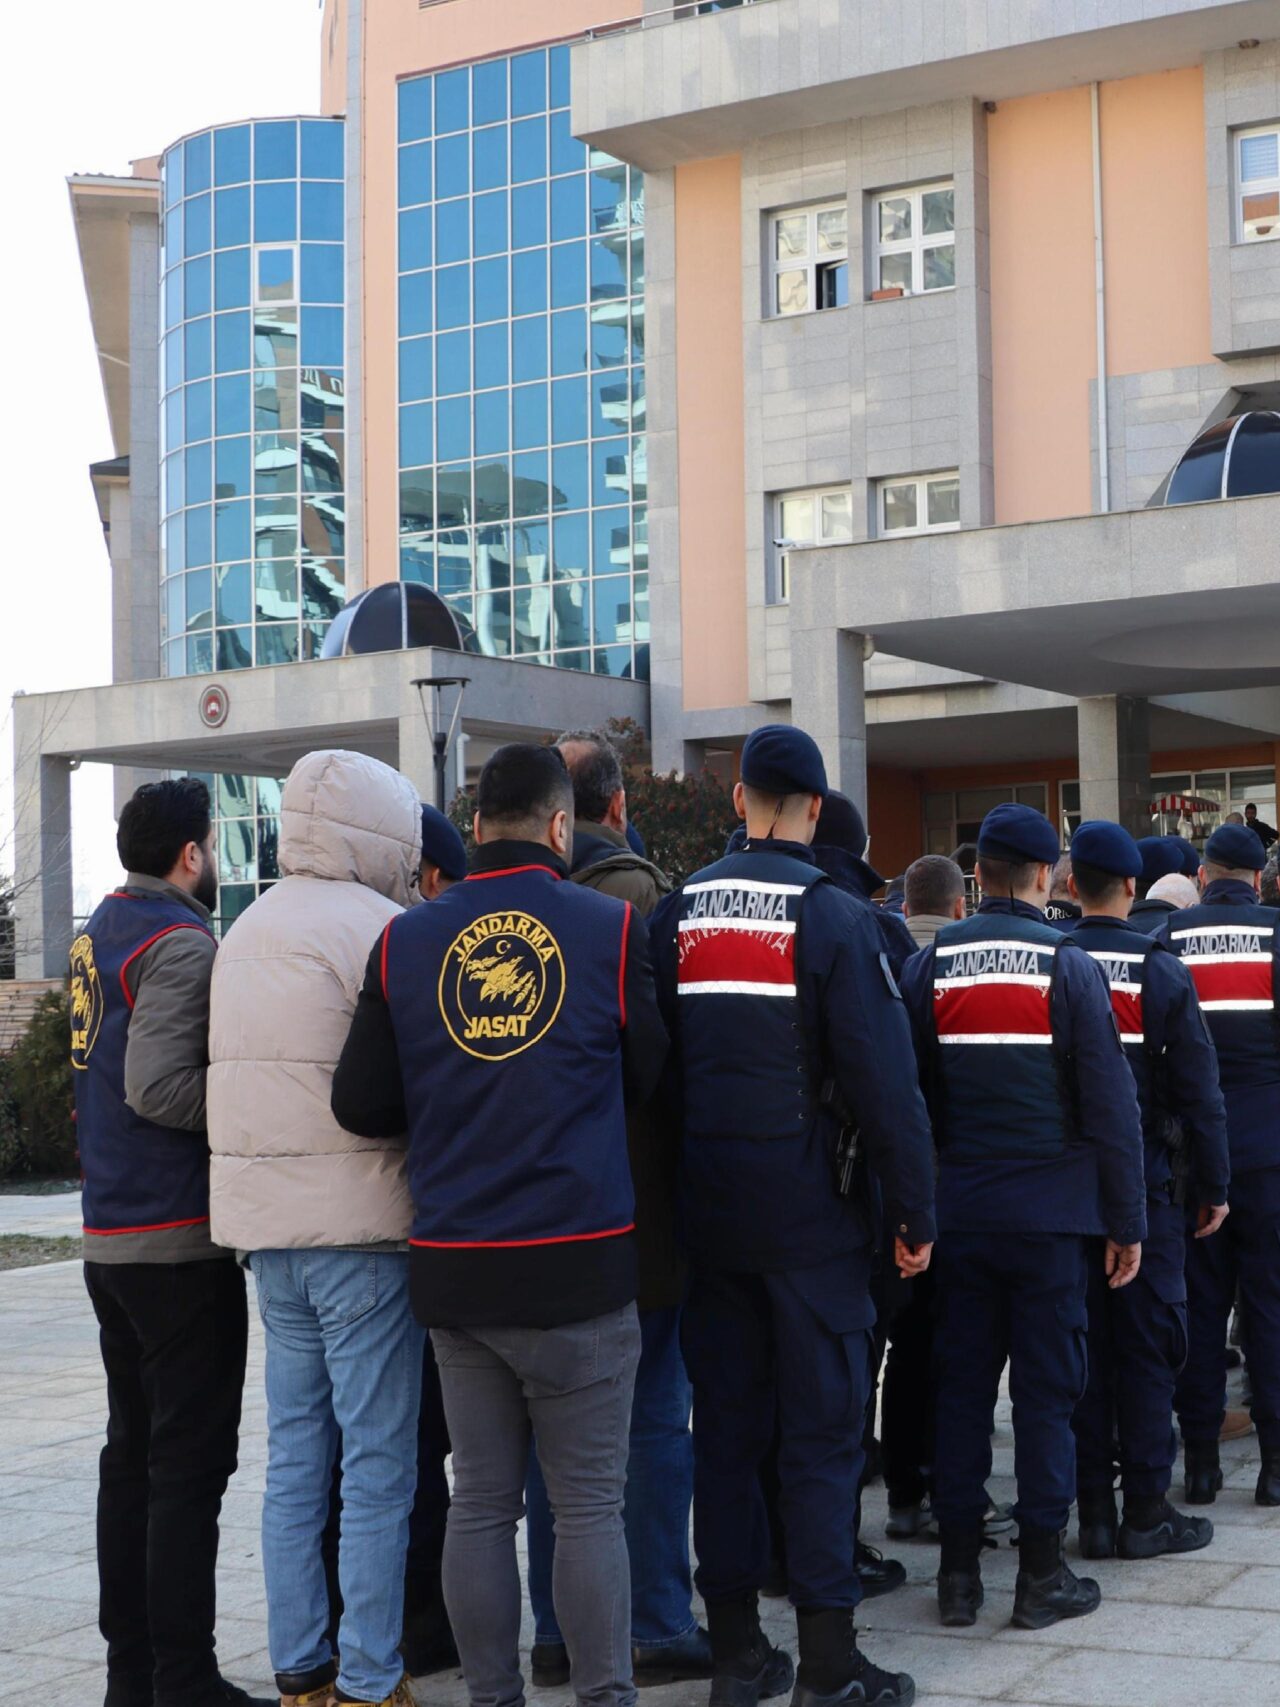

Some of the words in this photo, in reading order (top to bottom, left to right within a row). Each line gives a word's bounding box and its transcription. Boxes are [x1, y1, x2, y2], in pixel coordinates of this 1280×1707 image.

[687, 889, 788, 921] JANDARMA
[453, 915, 556, 963] JANDARMA
[1181, 933, 1262, 956] JANDARMA
[944, 948, 1039, 978] JANDARMA
[464, 1014, 532, 1039] JASAT
